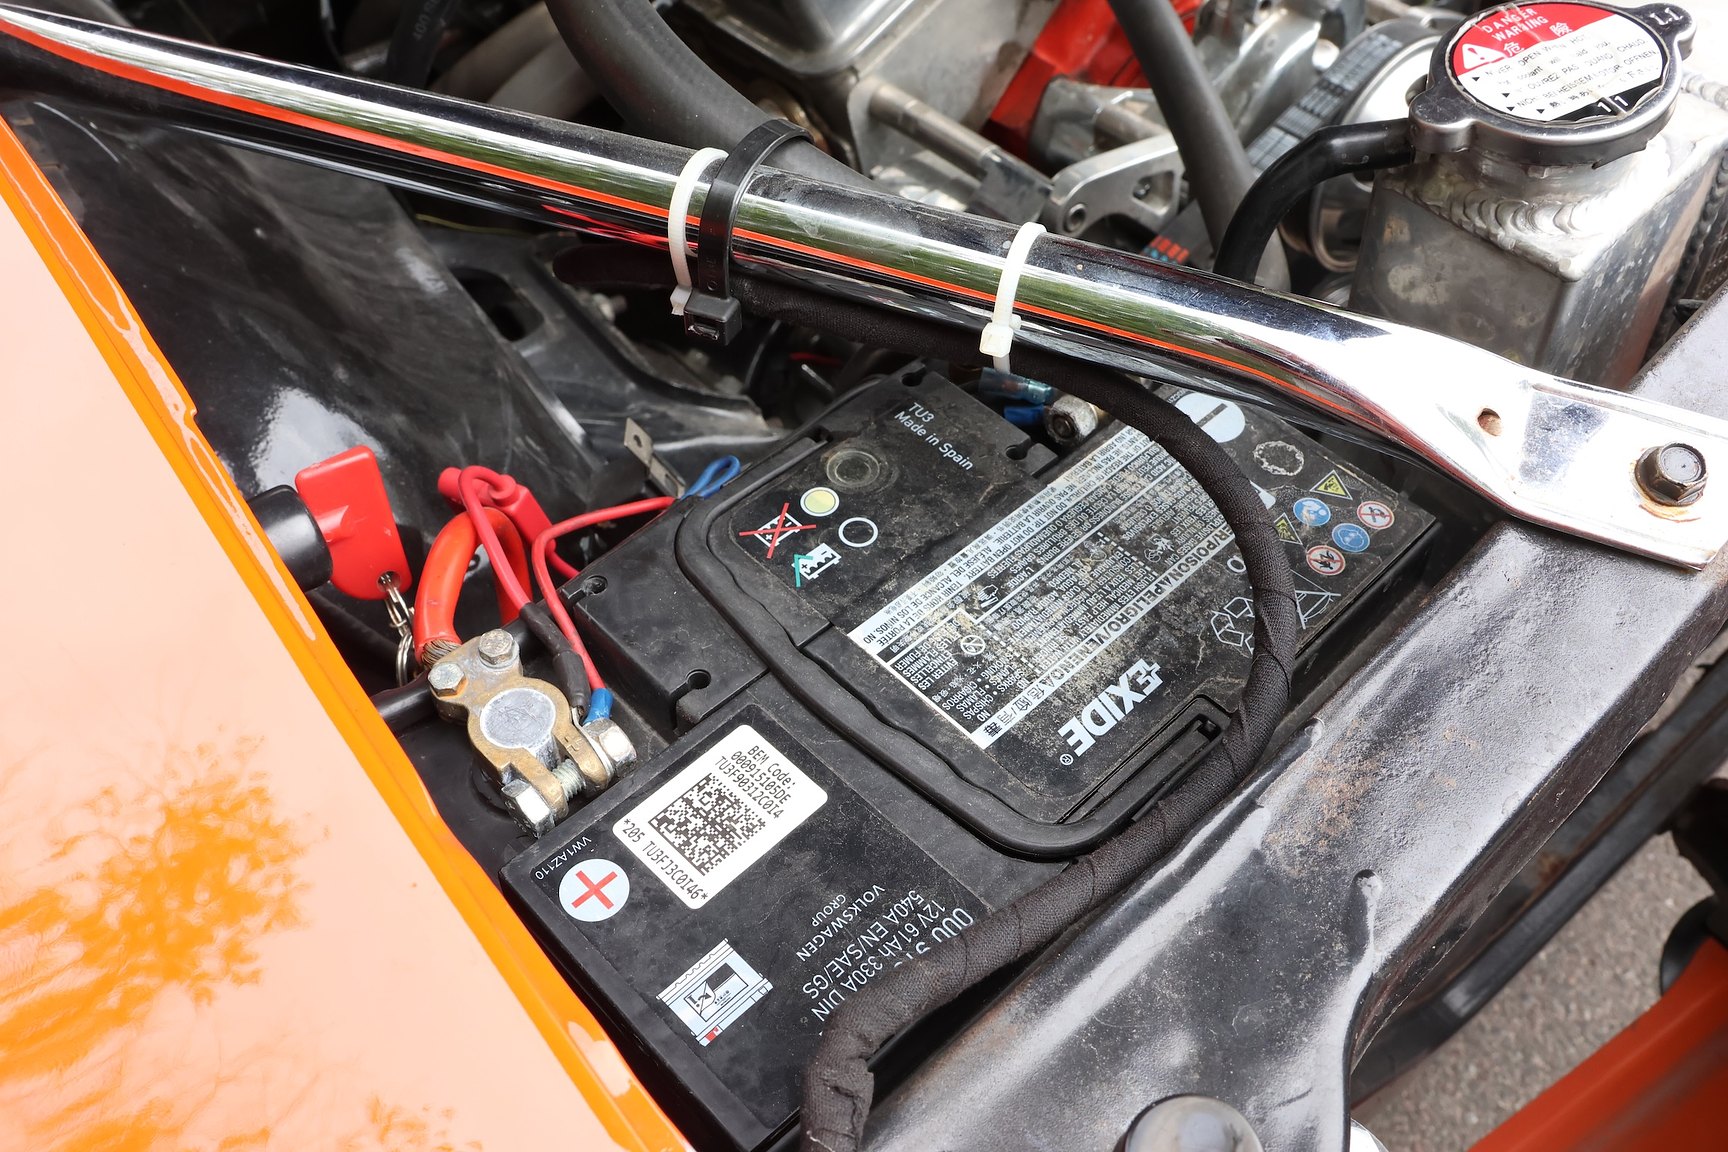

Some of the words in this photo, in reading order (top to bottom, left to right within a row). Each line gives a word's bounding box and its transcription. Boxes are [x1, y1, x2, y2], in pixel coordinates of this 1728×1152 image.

[1482, 8, 1538, 33] DANGER
[1491, 16, 1549, 41] WARNING
[907, 401, 935, 423] TU3
[893, 409, 928, 437] Made
[924, 431, 941, 446] in
[936, 440, 975, 471] Spain
[1096, 440, 1116, 456] ABRIR
[1088, 453, 1099, 462] LA
[1100, 453, 1114, 465] PAS
[1119, 450, 1133, 462] THE
[1100, 458, 1123, 476] REACH
[1149, 462, 1166, 477] ACID
[1052, 488, 1068, 501] PAS
[1064, 482, 1077, 492] NE
[1030, 497, 1056, 517] OUVRIR
[1042, 508, 1057, 520] NOT
[1054, 500, 1067, 511] DO
[1058, 498, 1089, 523] CEGUERA
[1087, 496, 1124, 525] BLINDNESS
[1022, 513, 1034, 523] LA
[1031, 517, 1045, 529] TIP.
[1063, 518, 1079, 531] DES
[1075, 511, 1089, 522] OU
[1078, 520, 1092, 532] OR
[1120, 510, 1158, 541] EXPLOSIVOS
[991, 520, 1026, 546] BATTERIE.
[1008, 533, 1024, 546] NOT
[1012, 523, 1058, 558] QUEMADURAS
[1021, 525, 1034, 536] DO
[1056, 528, 1082, 549] SEVERE
[991, 542, 1012, 558] OPEN
[1035, 545, 1060, 565] BURNS
[1175, 537, 1198, 556] GASES
[948, 565, 965, 579] DEL
[962, 555, 995, 581] BATTERY.
[985, 554, 1017, 579] FUERTES
[1008, 551, 1036, 574] GRAVES
[1070, 559, 1083, 569] AL
[1095, 555, 1131, 586] CONSULTER
[1123, 561, 1139, 574] LES
[1107, 571, 1127, 588] YEUX
[1131, 567, 1147, 580] GET
[1132, 573, 1155, 592] FLUSH
[919, 575, 953, 601] ALCANCE
[940, 580, 962, 597] TENIR
[1061, 584, 1081, 600] OJOS
[1085, 582, 1099, 593] UN
[1085, 588, 1106, 606] L'EAU
[1104, 576, 1136, 603] MEDICAL
[1117, 588, 1136, 605] EYES
[909, 597, 923, 608] DE
[1033, 589, 1059, 610] ACUDA
[1089, 598, 1109, 615] HELP
[895, 604, 913, 618] LOS
[901, 615, 915, 627] LA
[911, 608, 925, 619] DE
[1071, 611, 1093, 630] FAST.
[1078, 601, 1121, 638] IMMEDIATELY
[872, 614, 901, 637] NIÑOS.
[875, 623, 907, 647] PORTÉE
[1048, 581, 1166, 682] PELIGRO/VENENO
[861, 632, 876, 644] NO
[917, 641, 931, 653] DE
[934, 637, 952, 651] LES
[893, 648, 921, 671] FUMER
[900, 647, 939, 678] FLAMMES
[930, 657, 960, 681] ÉVITER
[979, 650, 1014, 680] SMOKING
[916, 675, 935, 691] LES
[994, 667, 1025, 693] SPARKS
[940, 679, 978, 711] CIGARROS
[954, 686, 986, 713] FLAMAS
[961, 692, 994, 720] CHISPAS
[975, 709, 991, 722] NO
[981, 683, 1046, 739] 危险/有毒
[730, 749, 791, 804] 000915105DE
[747, 744, 770, 765] BEM
[766, 761, 798, 790] Code:
[714, 755, 784, 820] TU3F90312C0I4
[533, 834, 591, 880] VW1AZ110
[807, 891, 847, 928] GROUP
[881, 888, 924, 925] 540A
[914, 898, 946, 929] 12V
[794, 883, 886, 962] VOLKSWAGEN
[876, 921, 920, 961] 61Ah
[799, 920, 888, 1001] EN/SAE/GS
[839, 954, 883, 994] 330A
[810, 988, 845, 1022] DIN
